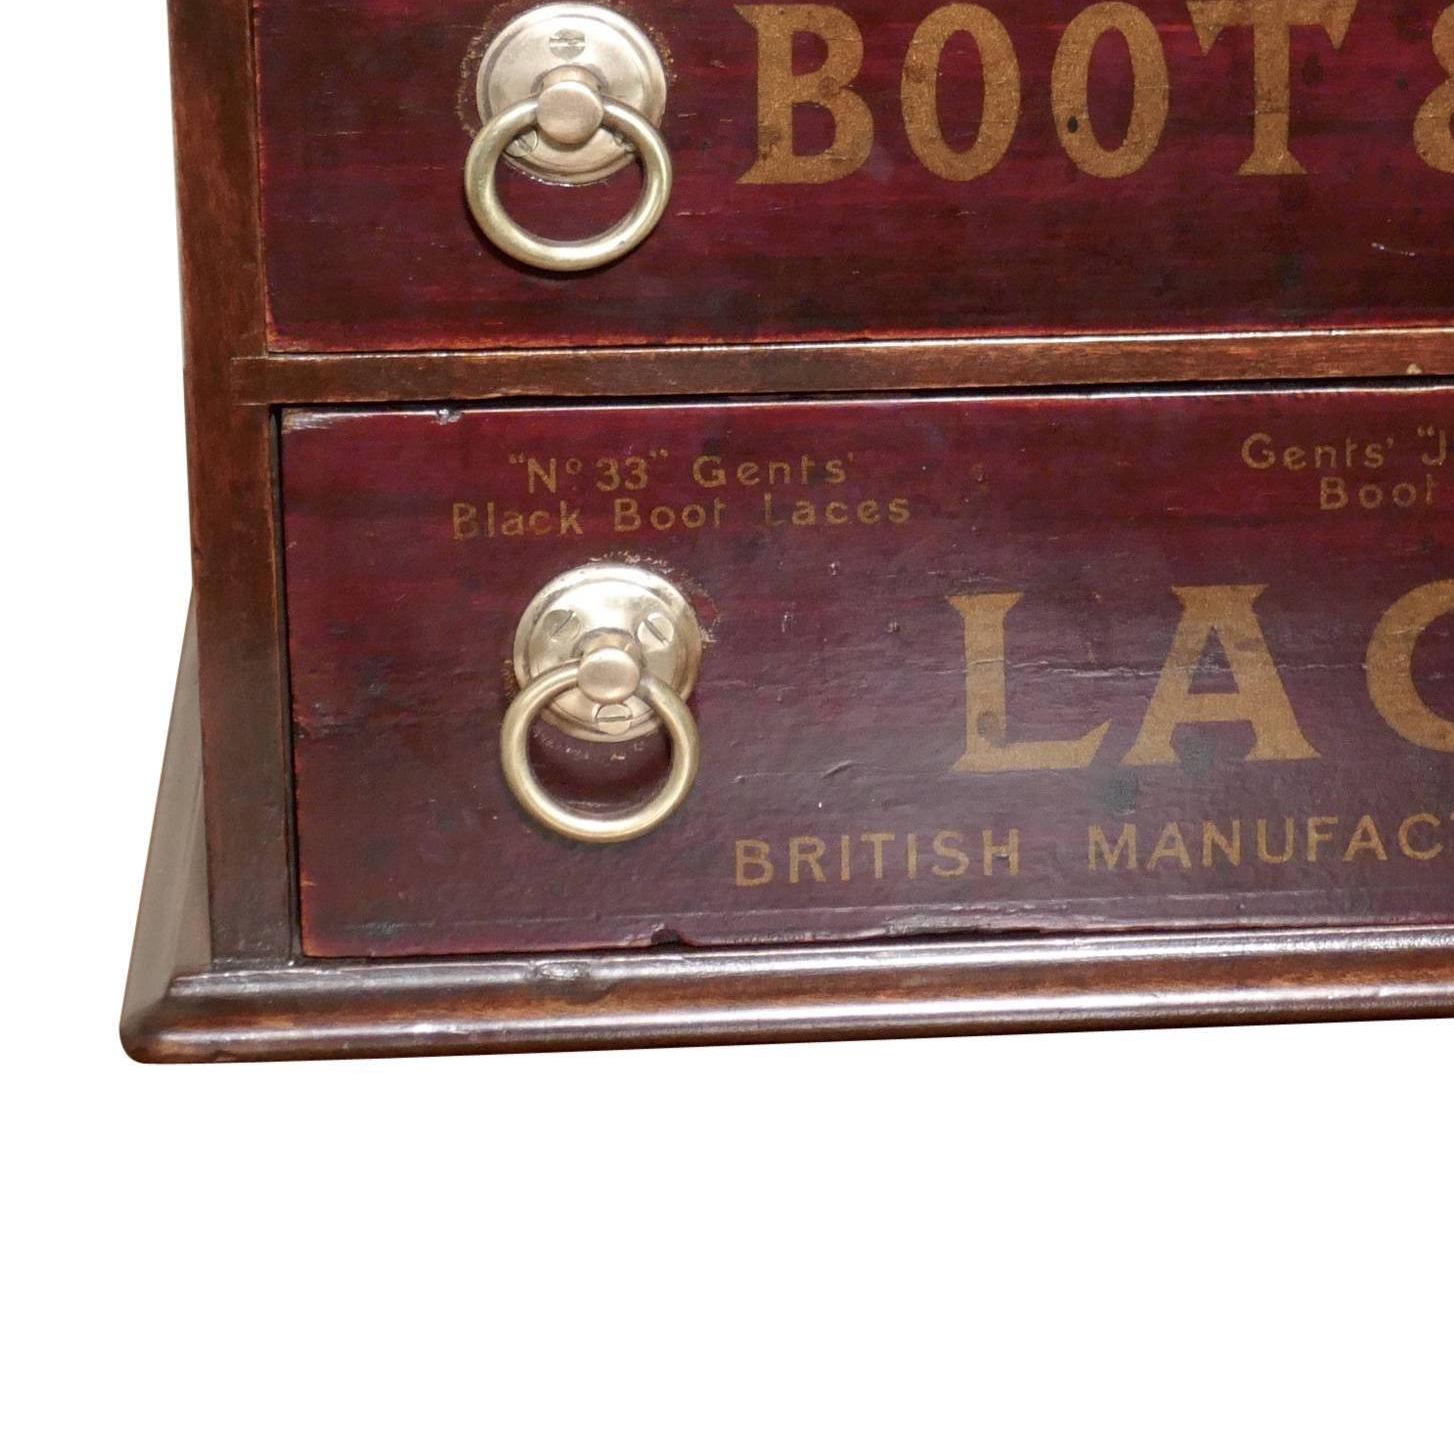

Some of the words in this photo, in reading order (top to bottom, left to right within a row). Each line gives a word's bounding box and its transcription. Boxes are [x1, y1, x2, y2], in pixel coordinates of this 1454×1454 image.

[596, 448, 670, 492] 33"
[693, 451, 855, 488] Gents'
[1240, 432, 1394, 470] Gents'
[1319, 473, 1437, 510] Boot
[452, 500, 584, 541] Black
[613, 497, 726, 533] Boot
[763, 492, 911, 529] Laces
[734, 828, 1021, 887] BRITISH
